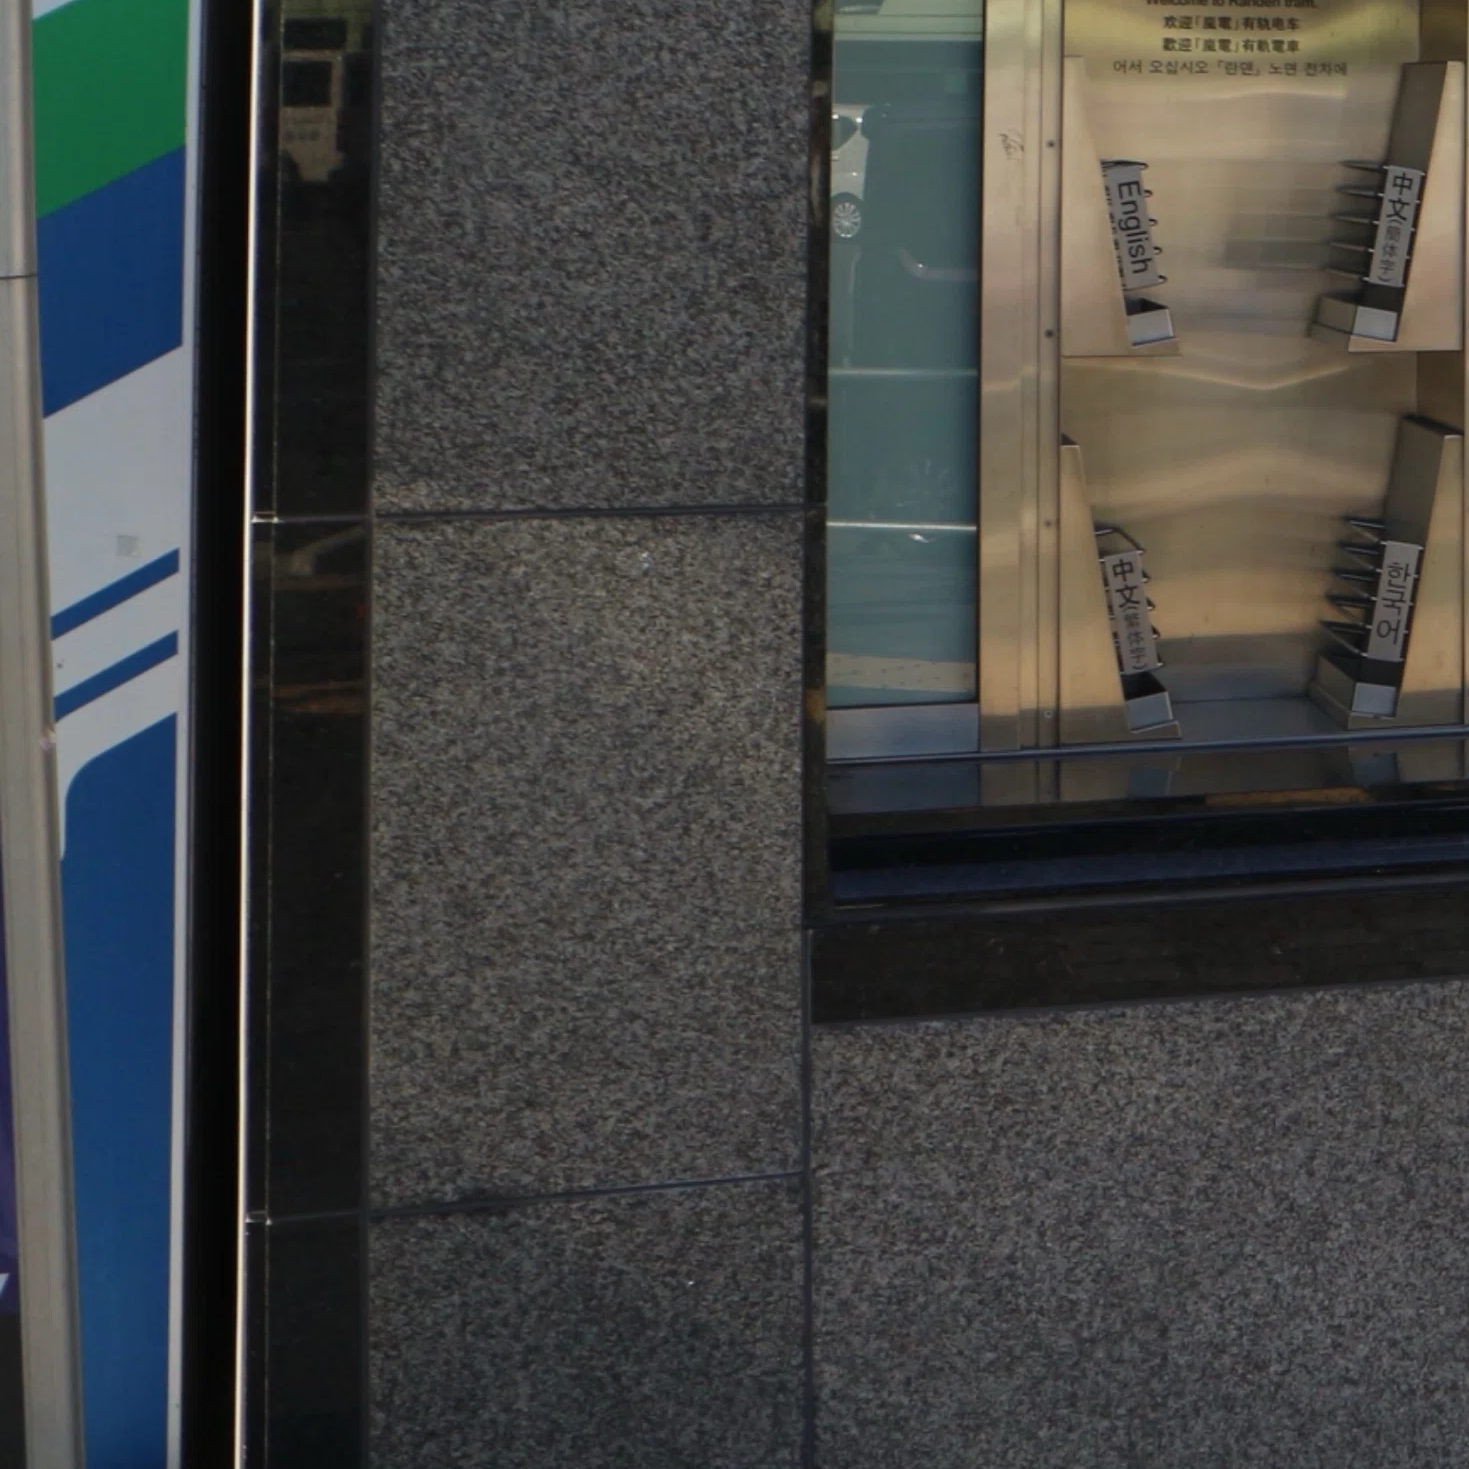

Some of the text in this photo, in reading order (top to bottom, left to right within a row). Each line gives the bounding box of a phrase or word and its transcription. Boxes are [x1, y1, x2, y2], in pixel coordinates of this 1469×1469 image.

[1114, 60, 1142, 74] 어서
[1118, 179, 1152, 275] English
[1376, 561, 1410, 644] 한국어
